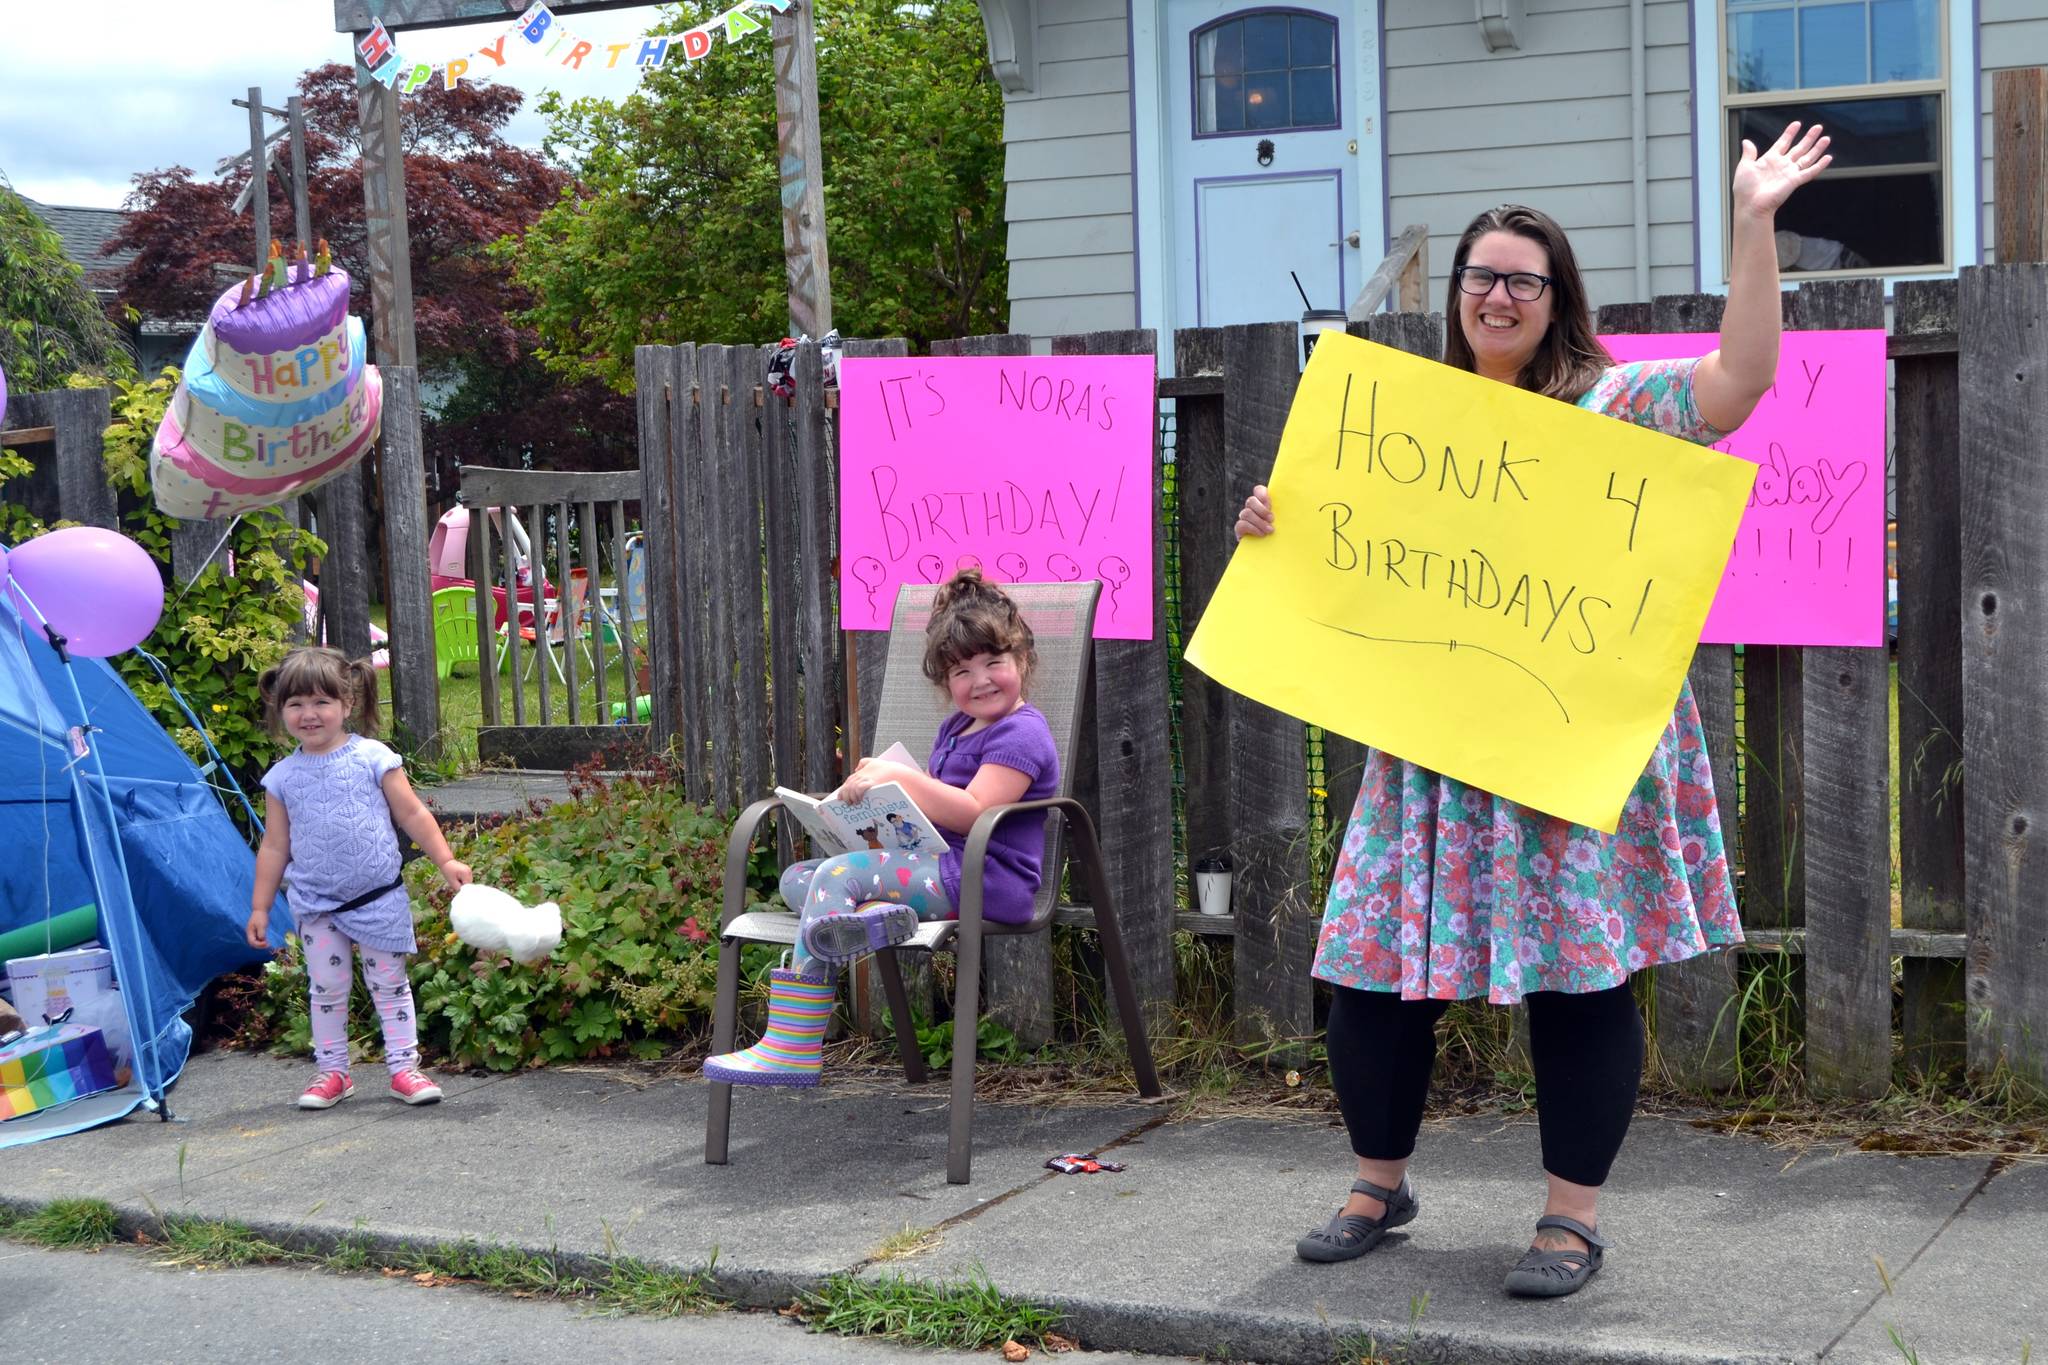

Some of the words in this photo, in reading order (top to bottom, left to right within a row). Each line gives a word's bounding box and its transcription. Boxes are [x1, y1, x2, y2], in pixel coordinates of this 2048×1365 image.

[357, 23, 507, 94] HAPPY
[522, 0, 791, 70] BIRTHDA
[879, 369, 946, 442] IT'S
[1336, 372, 1541, 502] HONK
[1606, 470, 1649, 552] 4
[871, 464, 1126, 562] BIRTHDAY!
[1318, 501, 1653, 661] BIRTHDAYS!
